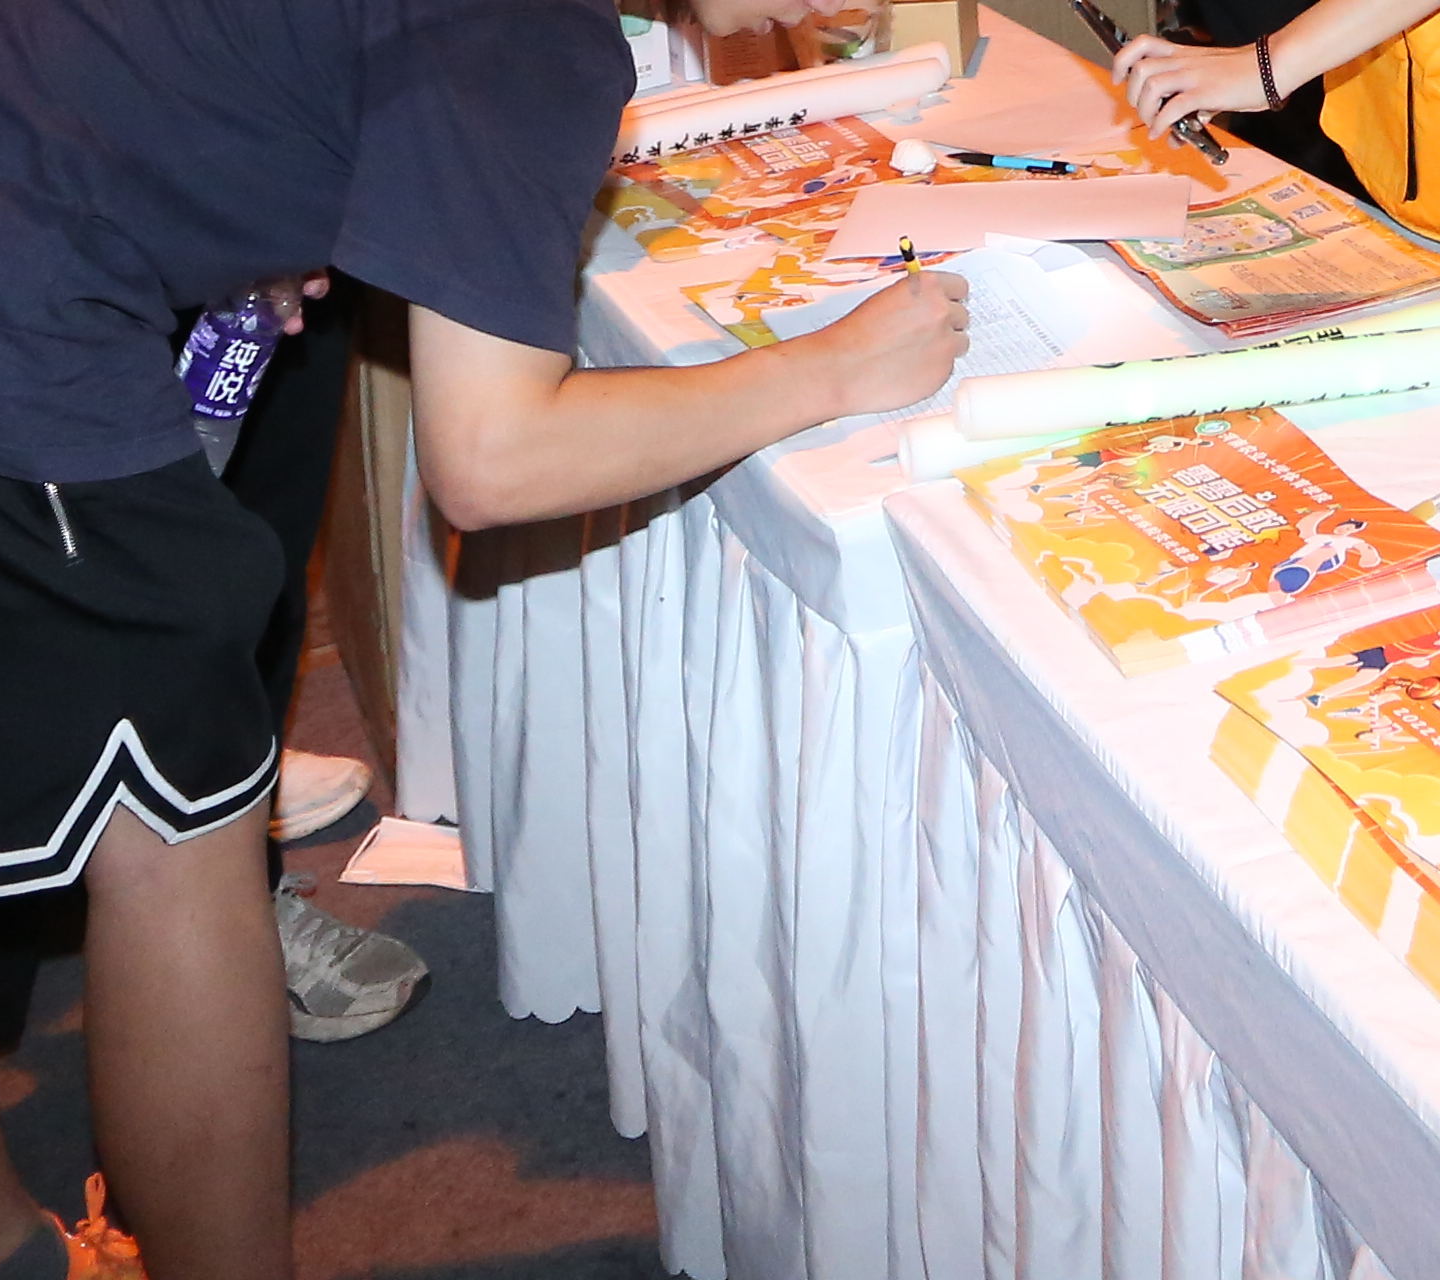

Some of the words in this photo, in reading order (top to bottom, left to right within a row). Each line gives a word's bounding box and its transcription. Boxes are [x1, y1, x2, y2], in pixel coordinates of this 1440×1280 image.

[205, 339, 260, 405] 纯悦
[1216, 431, 1335, 505] 河南农业大学体育学院
[1135, 481, 1255, 552] 无限可能
